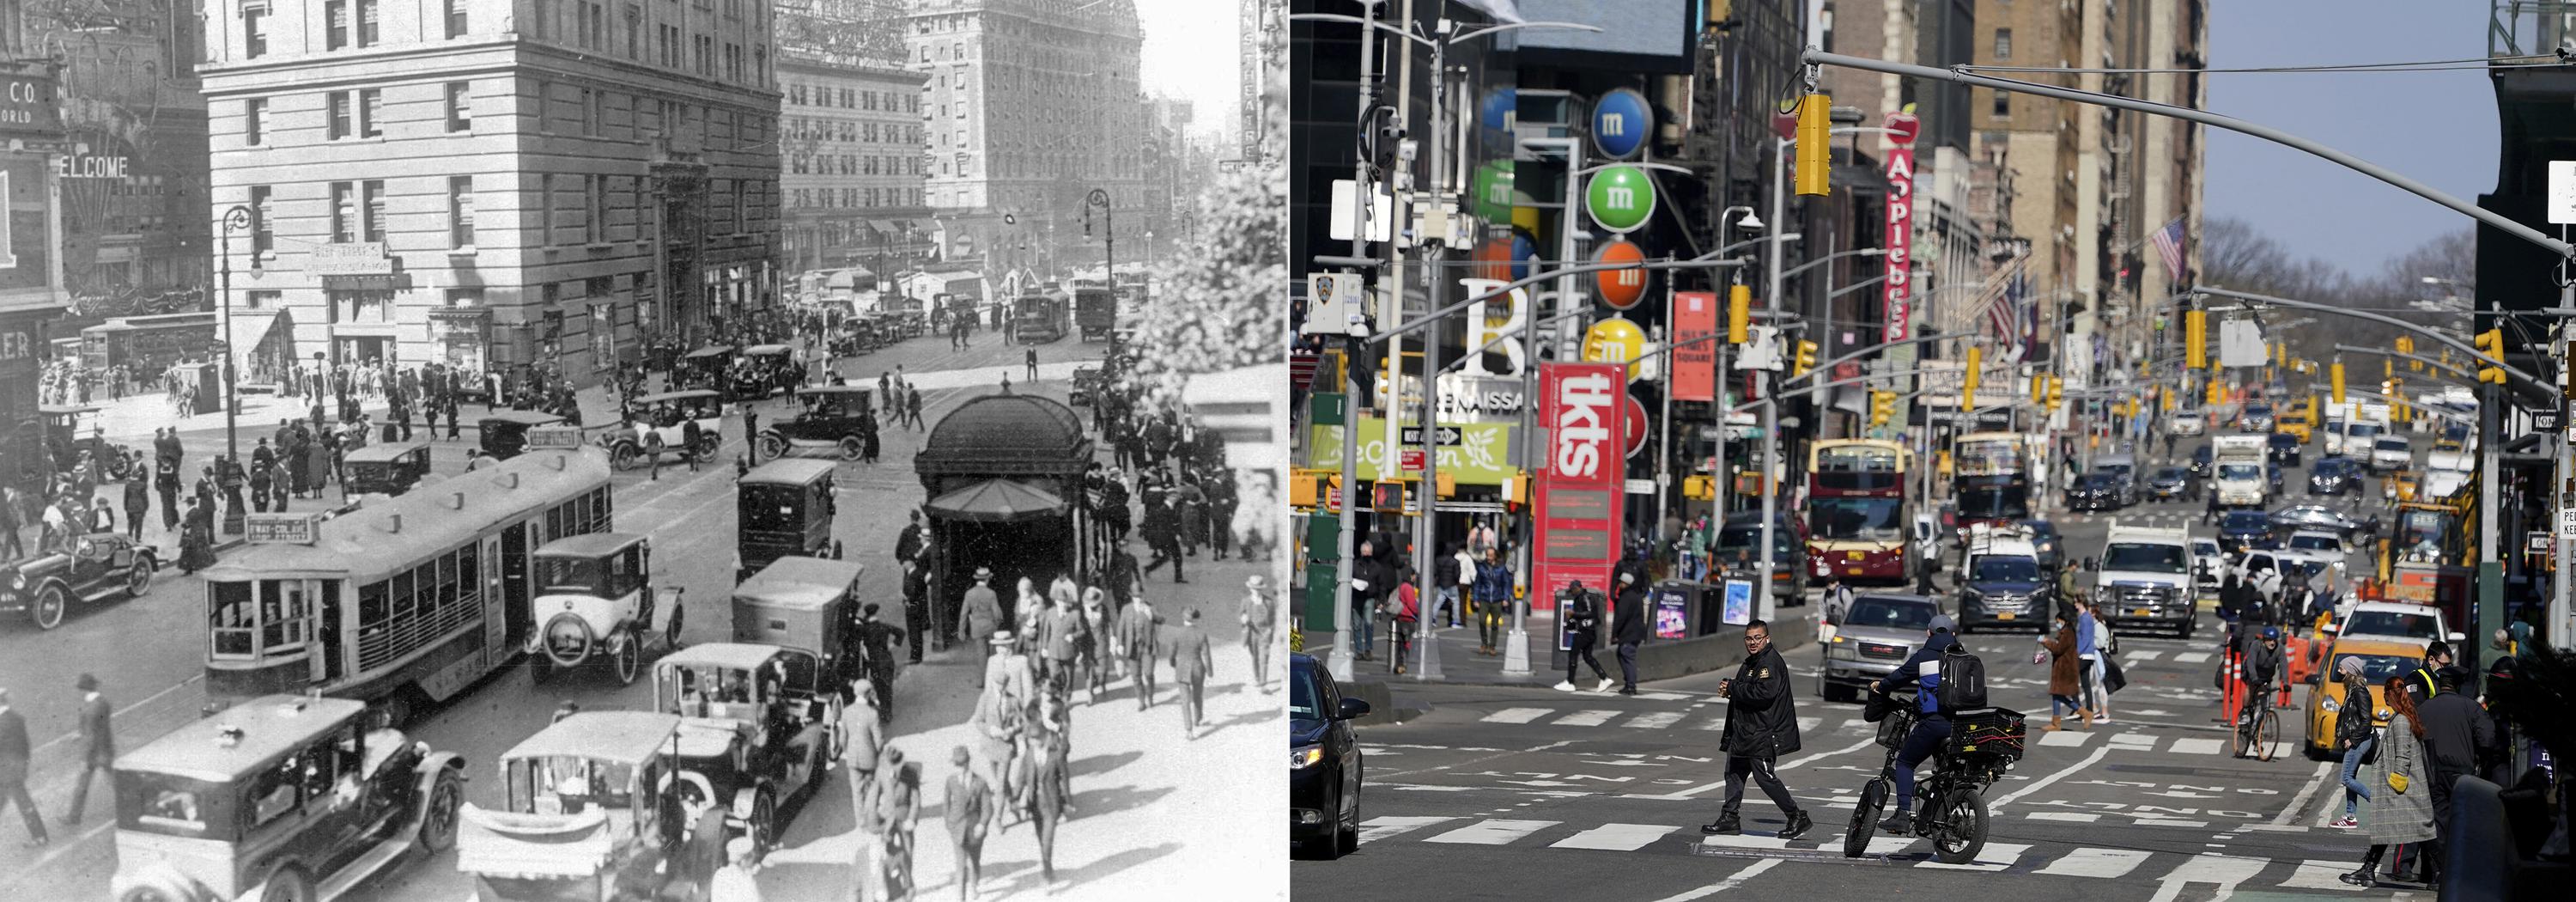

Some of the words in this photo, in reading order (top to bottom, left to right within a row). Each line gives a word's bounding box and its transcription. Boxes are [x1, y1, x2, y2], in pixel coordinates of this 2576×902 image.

[1, 109, 32, 123] ORLD
[1243, 53, 1257, 158] THEATRE
[1602, 113, 1623, 136] m
[59, 155, 128, 178] ELCOME
[1607, 186, 1634, 210] m
[1619, 267, 1639, 286] m
[0, 332, 30, 359] ER
[1602, 341, 1625, 364] m
[1676, 352, 1711, 363] SQUARE
[1437, 392, 1538, 414] ENAISSA
[1558, 373, 1613, 477] tkts
[2020, 800, 2264, 818] ONLY
